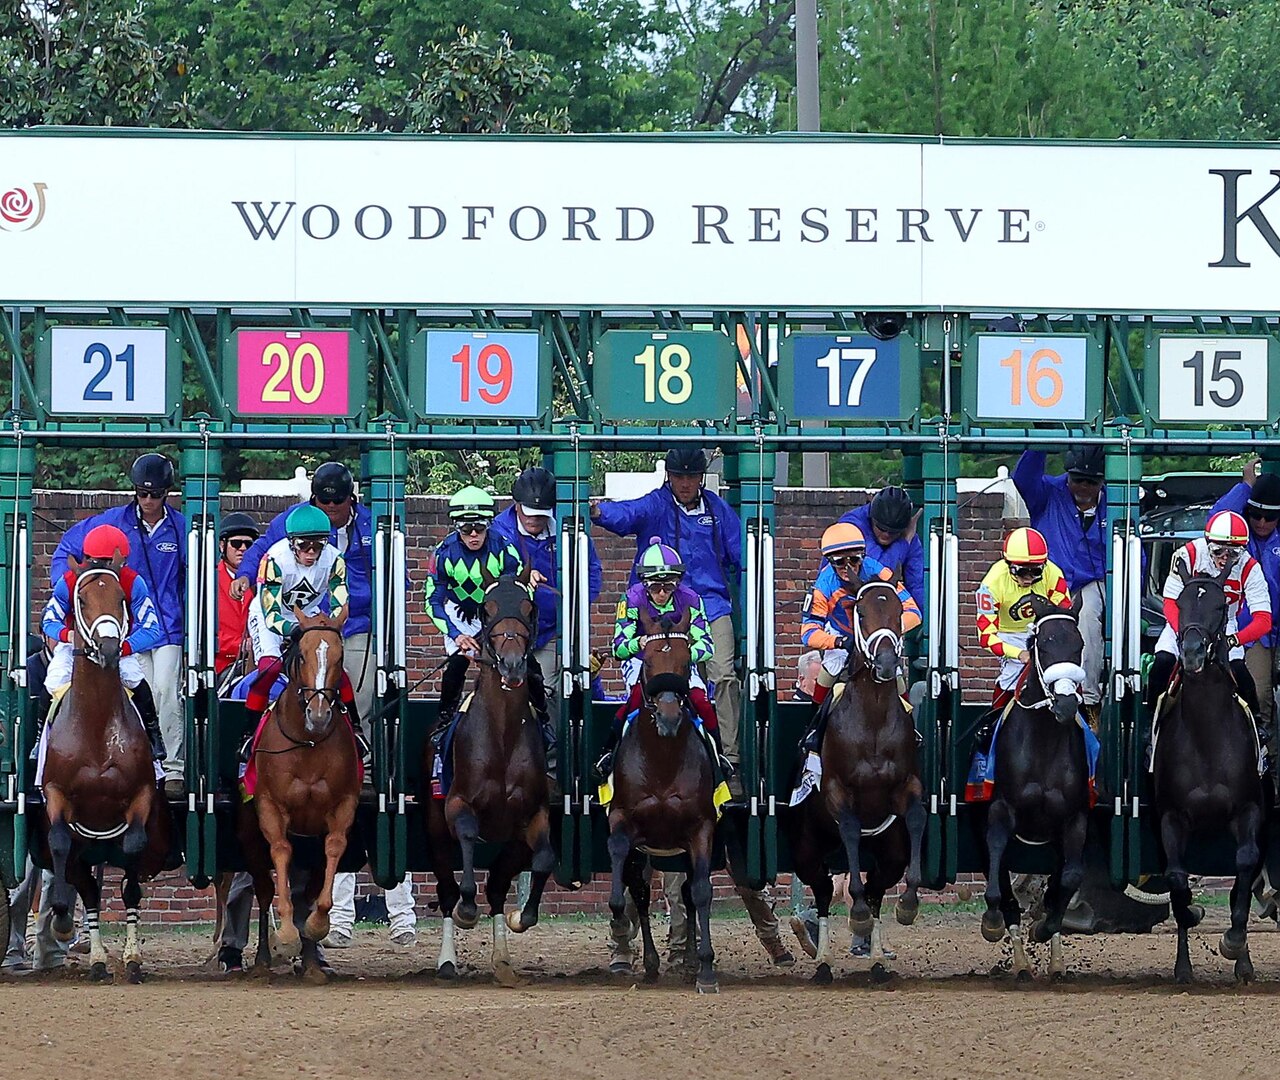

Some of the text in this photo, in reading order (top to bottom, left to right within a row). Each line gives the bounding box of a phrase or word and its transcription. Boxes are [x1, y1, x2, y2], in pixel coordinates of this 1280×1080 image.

[231, 201, 655, 242] WOODFORD
[83, 343, 135, 402] 21
[260, 342, 325, 405] 20
[451, 344, 514, 405] 19
[633, 344, 693, 405] 18
[816, 348, 877, 407] 17
[1000, 349, 1063, 407] 16
[1183, 351, 1244, 408] 15
[161, 542, 178, 552] Ford
[977, 593, 992, 611] 16
